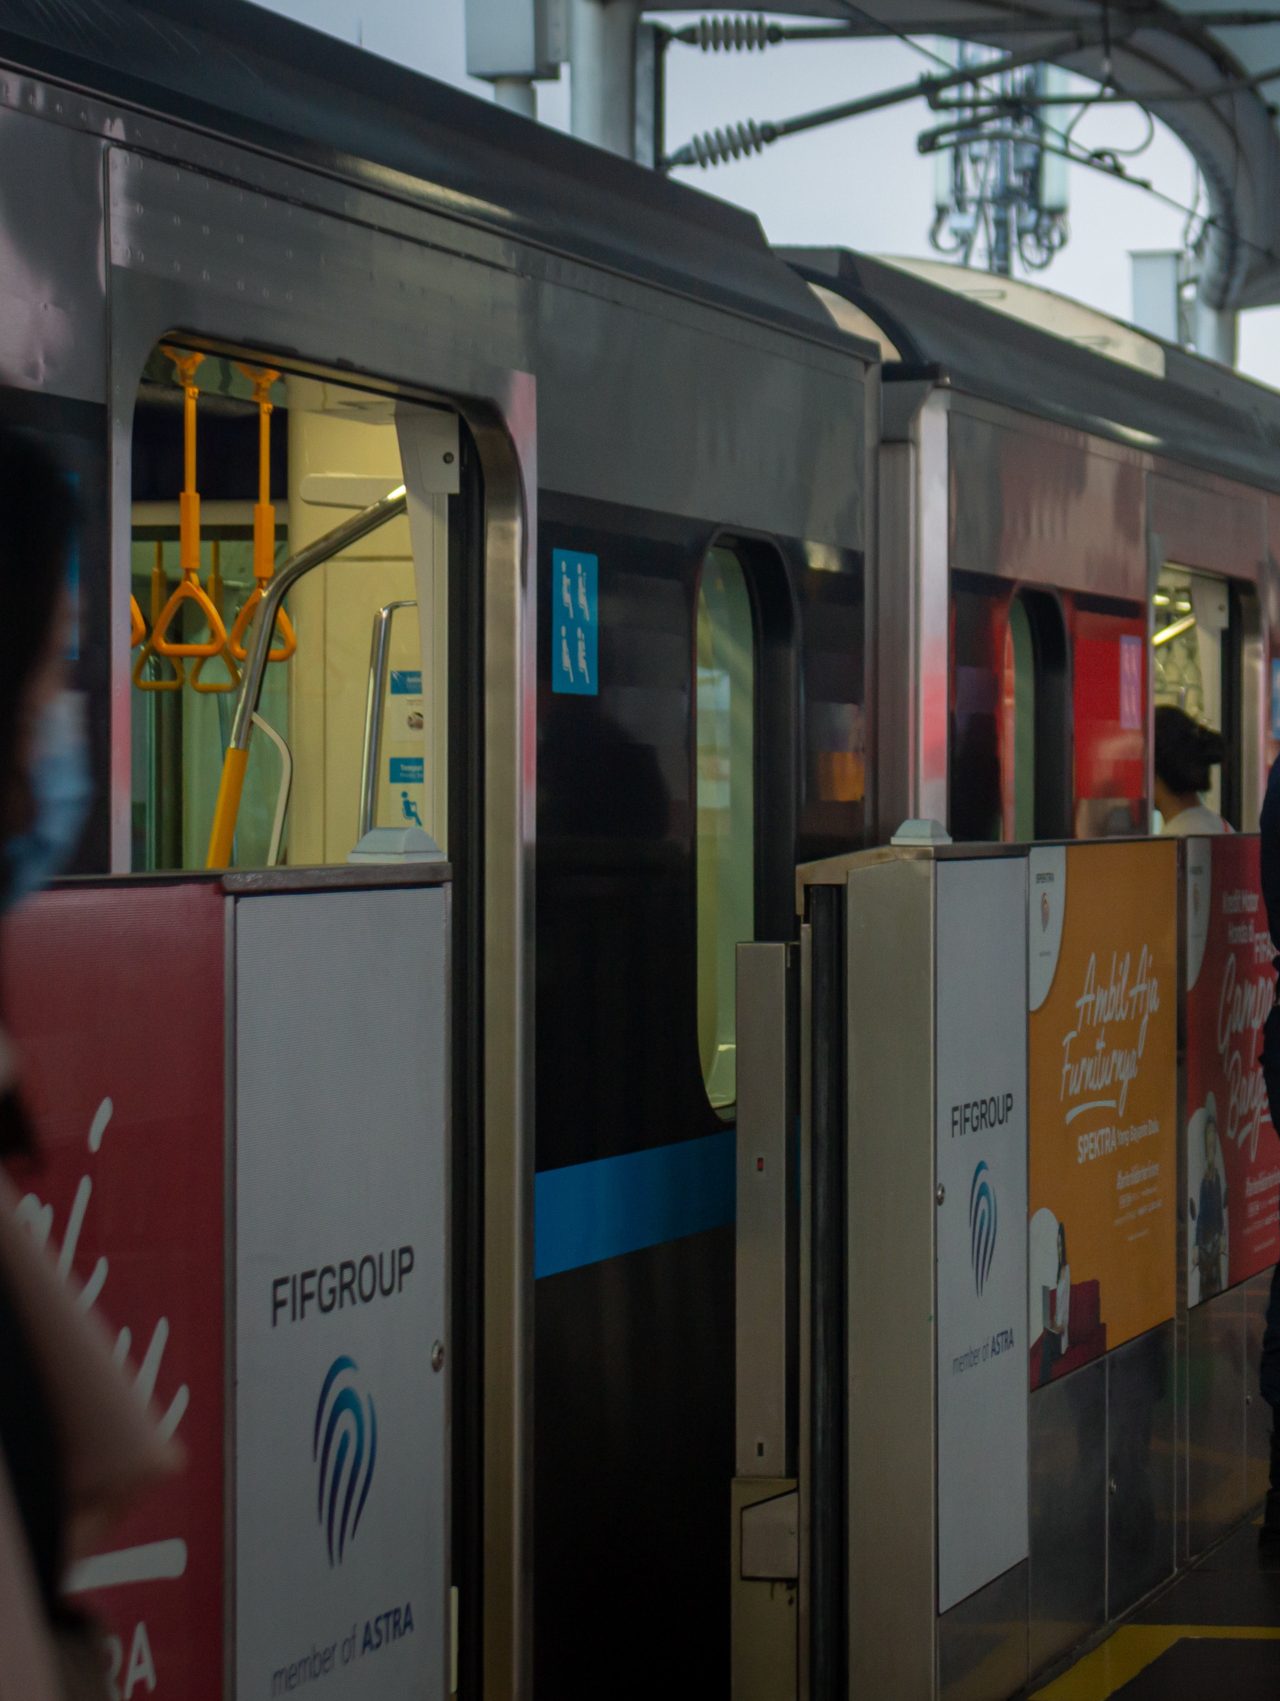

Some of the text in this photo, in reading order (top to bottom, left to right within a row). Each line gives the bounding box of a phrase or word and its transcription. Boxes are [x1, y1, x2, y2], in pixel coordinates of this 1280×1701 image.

[951, 1093, 1013, 1138] FIFGROUP
[1077, 1126, 1117, 1165] SPEKTRA
[271, 1244, 416, 1328] FIFGROUP
[991, 1327, 1015, 1358] ASTRA
[271, 1600, 416, 1699] member of ASTRA
